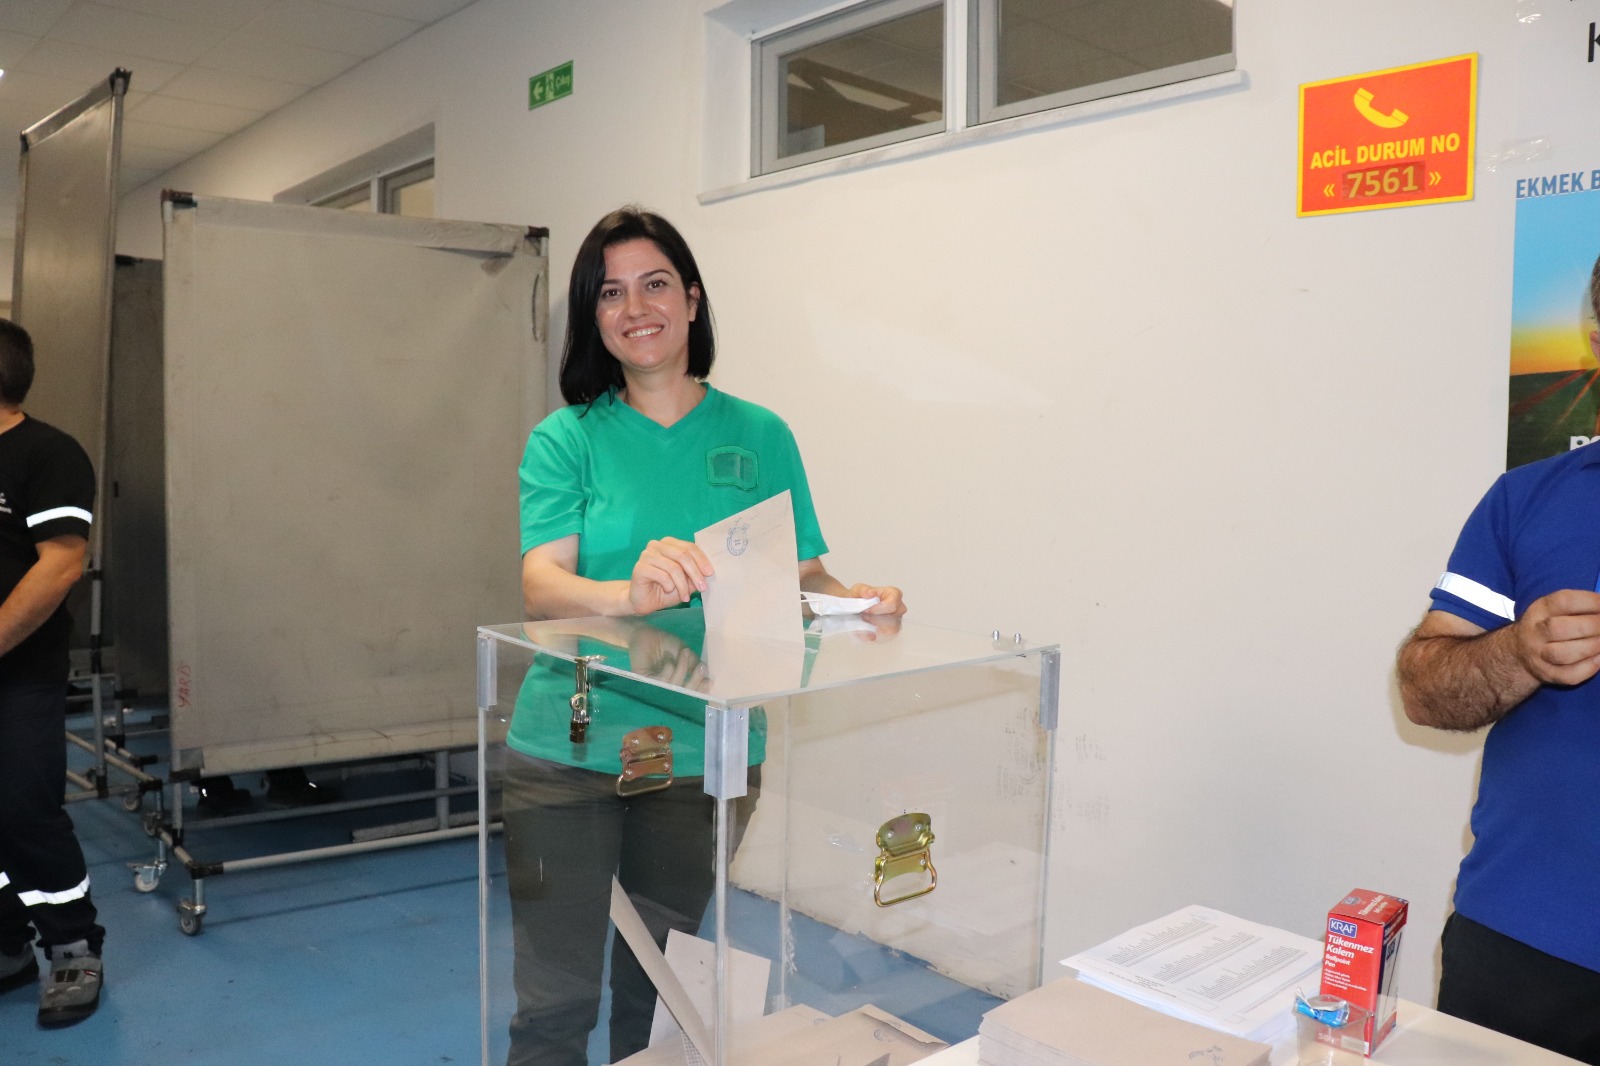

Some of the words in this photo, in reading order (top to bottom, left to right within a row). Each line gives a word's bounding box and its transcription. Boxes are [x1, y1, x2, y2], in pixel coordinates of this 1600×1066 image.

[1310, 145, 1351, 169] ACİL
[1356, 138, 1425, 163] DURUM
[1431, 133, 1460, 154] NO
[1346, 165, 1418, 199] 7561
[1516, 171, 1584, 199] EKMEK
[1330, 920, 1356, 935] KRAF
[1326, 944, 1355, 959] Kalem
[1328, 934, 1374, 954] Tükenmez
[1324, 960, 1336, 968] Pen
[1325, 954, 1351, 965] Ballpoint
